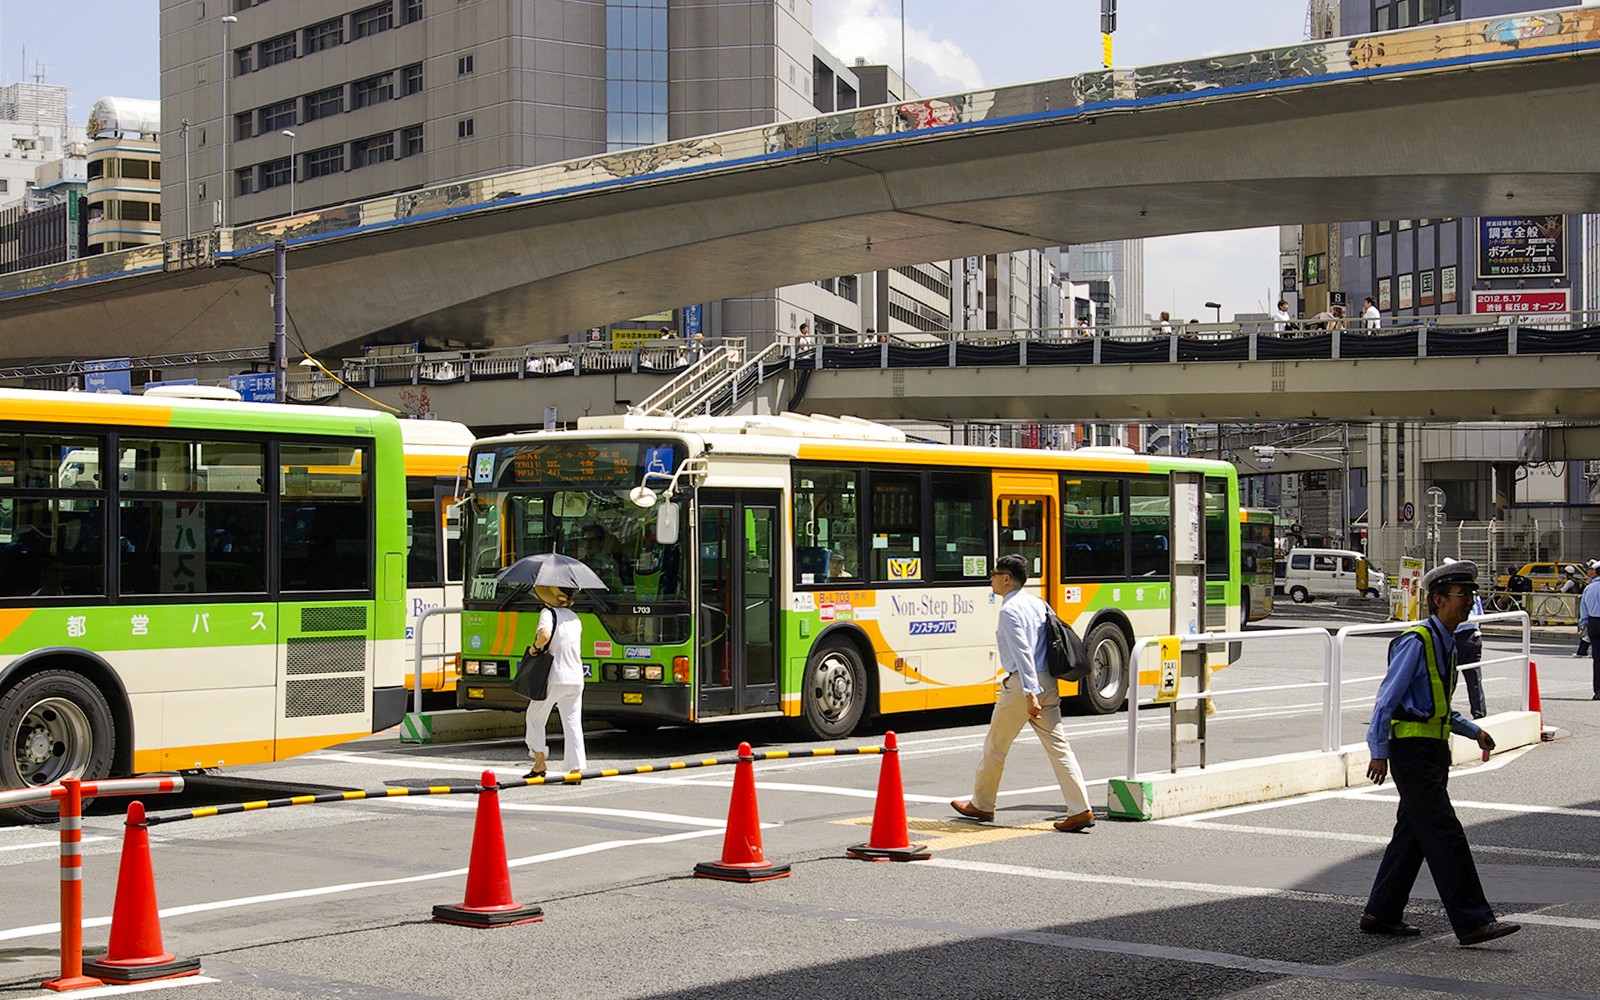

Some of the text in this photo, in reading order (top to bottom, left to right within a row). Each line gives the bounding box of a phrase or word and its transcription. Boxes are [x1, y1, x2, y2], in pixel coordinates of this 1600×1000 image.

[1488, 226, 1539, 239] 調査全般
[1488, 244, 1555, 258] ボディーガード
[1478, 295, 1522, 303] 2012.5.17
[1486, 303, 1502, 312] 渋谷
[1532, 302, 1564, 311] オープン
[472, 582, 495, 598] L703
[632, 606, 651, 614] L703
[953, 594, 974, 614] Bus
[67, 611, 267, 637] 都営バス
[910, 621, 957, 634] ノンステップバス
[1164, 661, 1176, 670] TAXI
